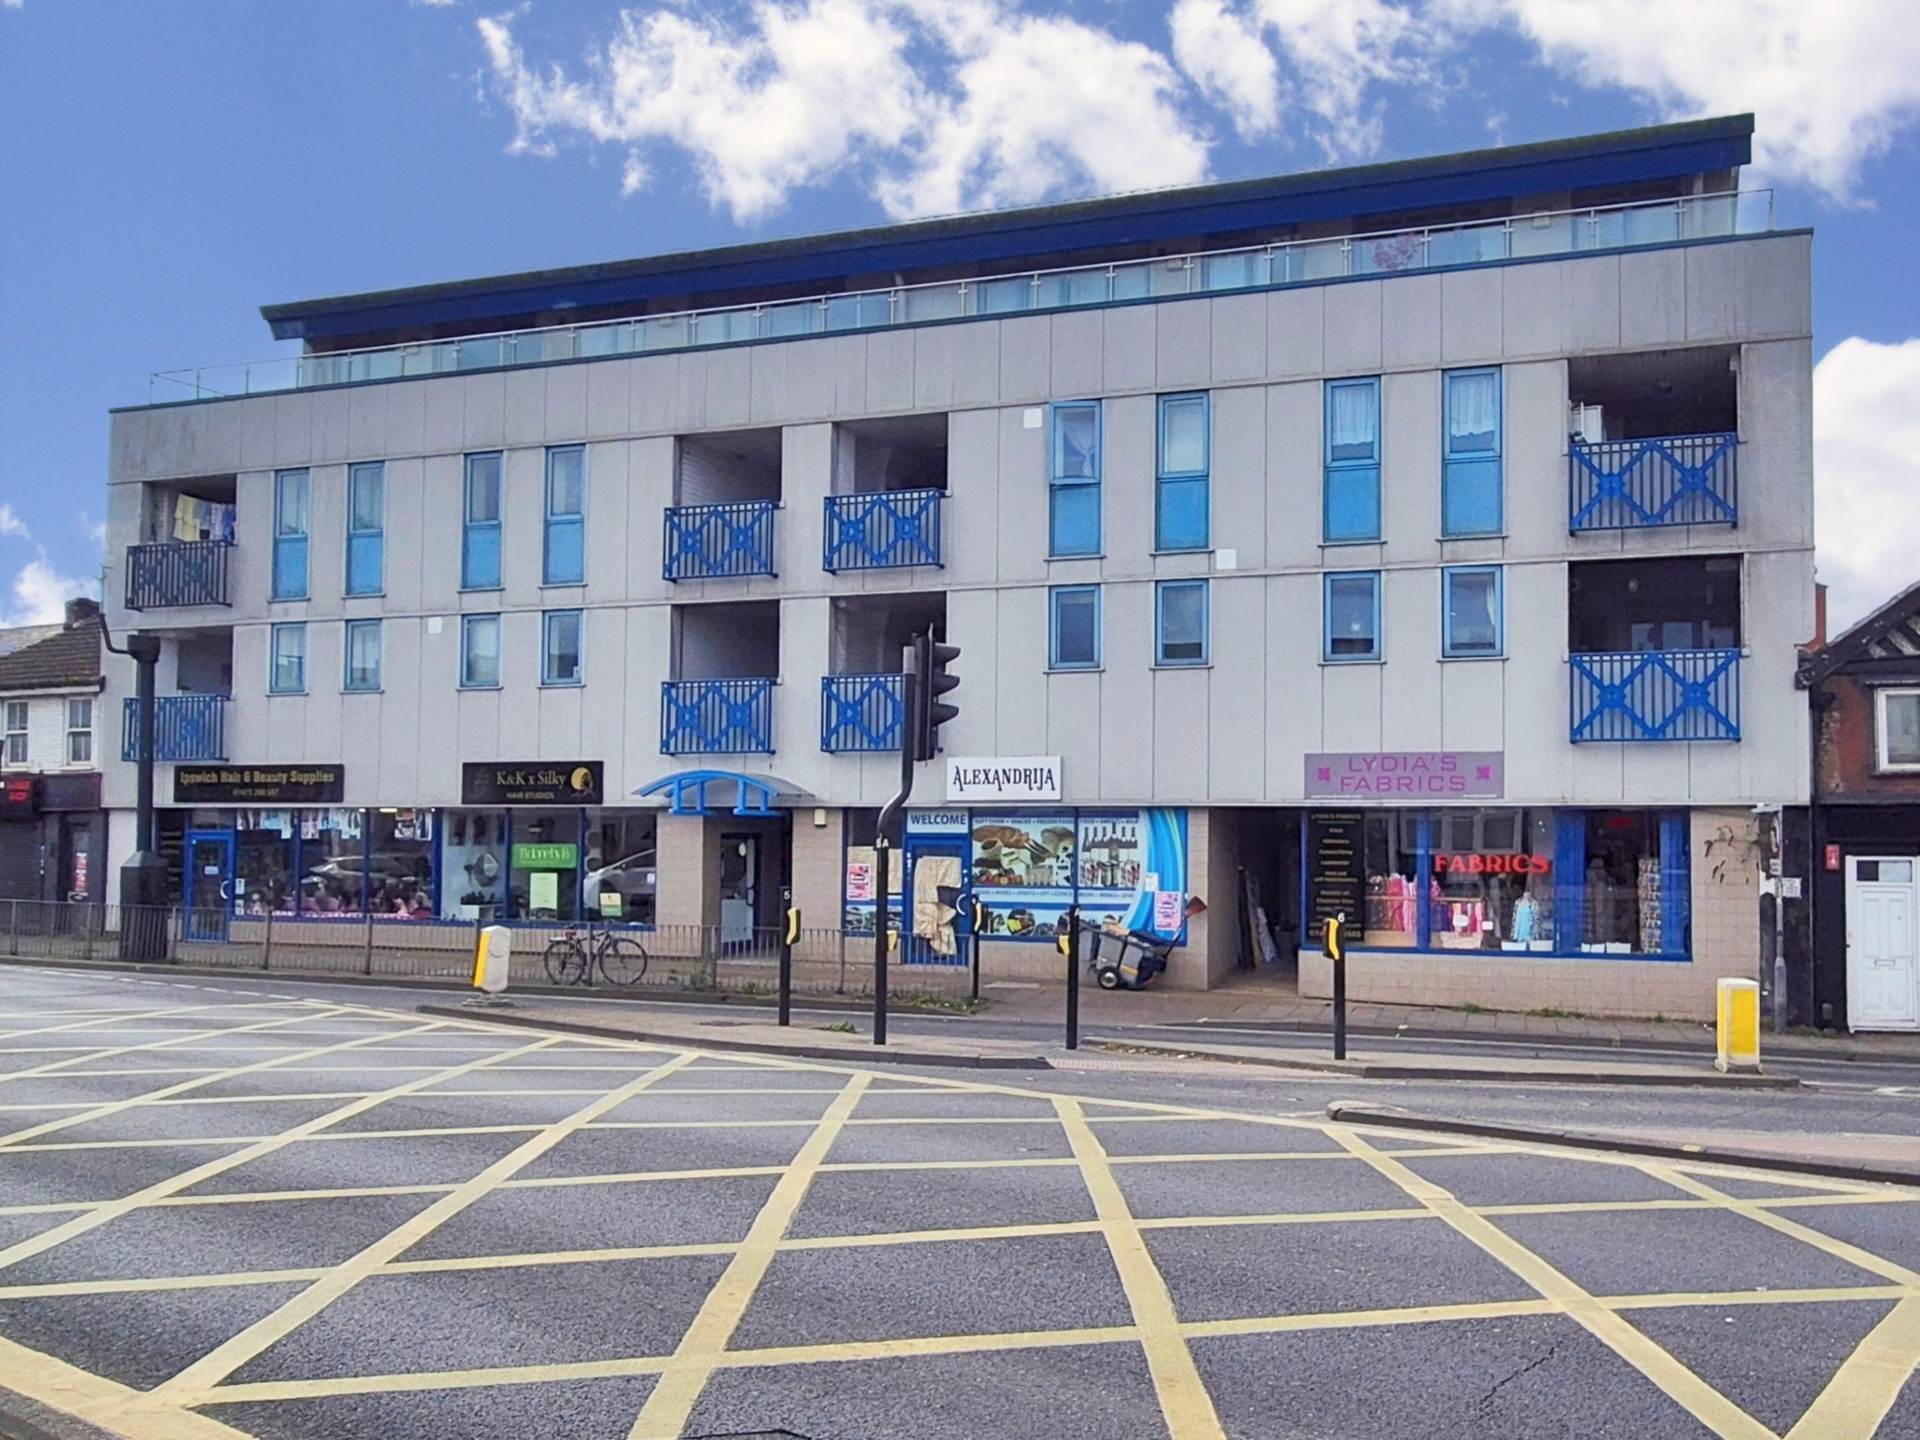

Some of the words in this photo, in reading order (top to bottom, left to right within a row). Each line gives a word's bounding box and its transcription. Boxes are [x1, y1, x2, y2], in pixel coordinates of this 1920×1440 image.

[1348, 755, 1457, 772] LYDIA'S
[180, 771, 218, 786] Ipswich
[220, 771, 241, 783] Hair
[253, 771, 288, 785] Beauty
[290, 770, 335, 786] Supplies
[496, 771, 526, 786] K&K
[537, 770, 566, 789] Silky
[952, 766, 1056, 792] ALEXANDRIJA
[1340, 775, 1465, 793] FABRICS
[911, 813, 966, 825] WELCOME
[1434, 854, 1549, 873] FABRICS
[1337, 912, 1345, 923] 6
